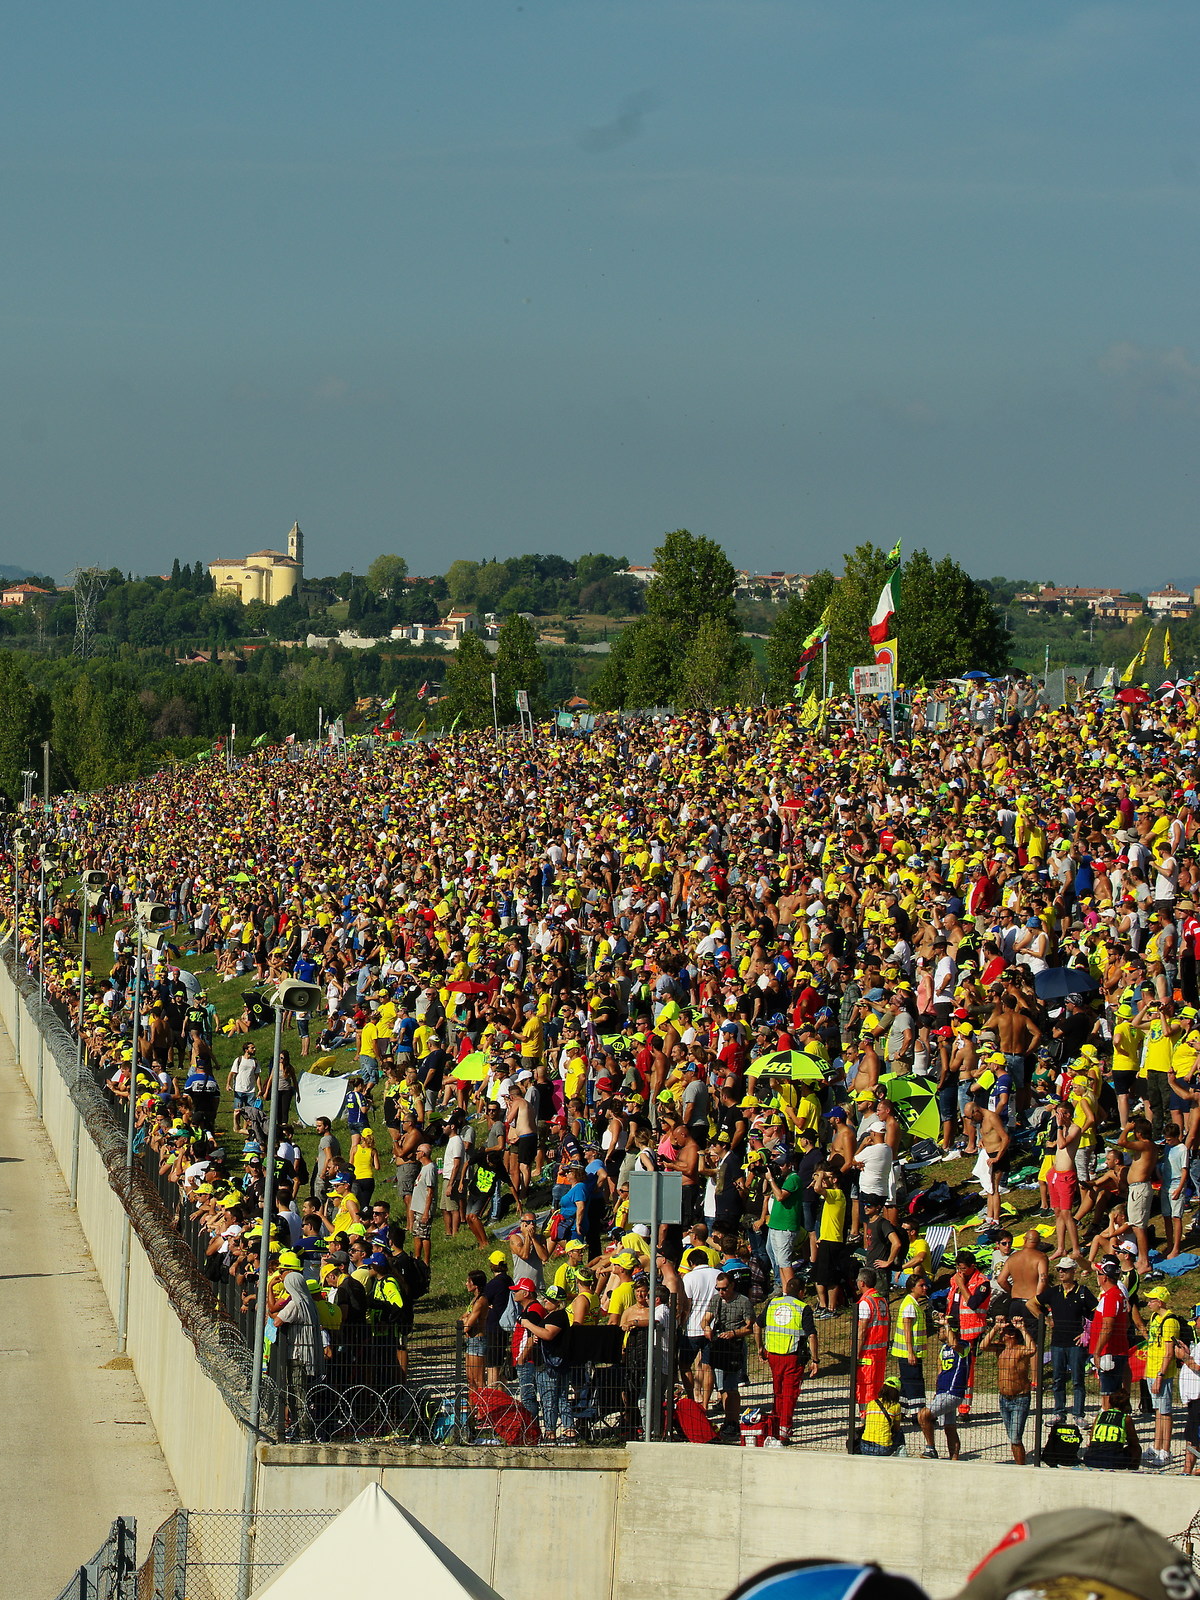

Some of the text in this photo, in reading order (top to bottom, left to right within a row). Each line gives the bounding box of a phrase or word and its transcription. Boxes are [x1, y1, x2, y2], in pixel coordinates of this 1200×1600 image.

[764, 1061, 792, 1073] 46
[314, 1239, 327, 1248] 46
[1095, 1425, 1119, 1443] 46
